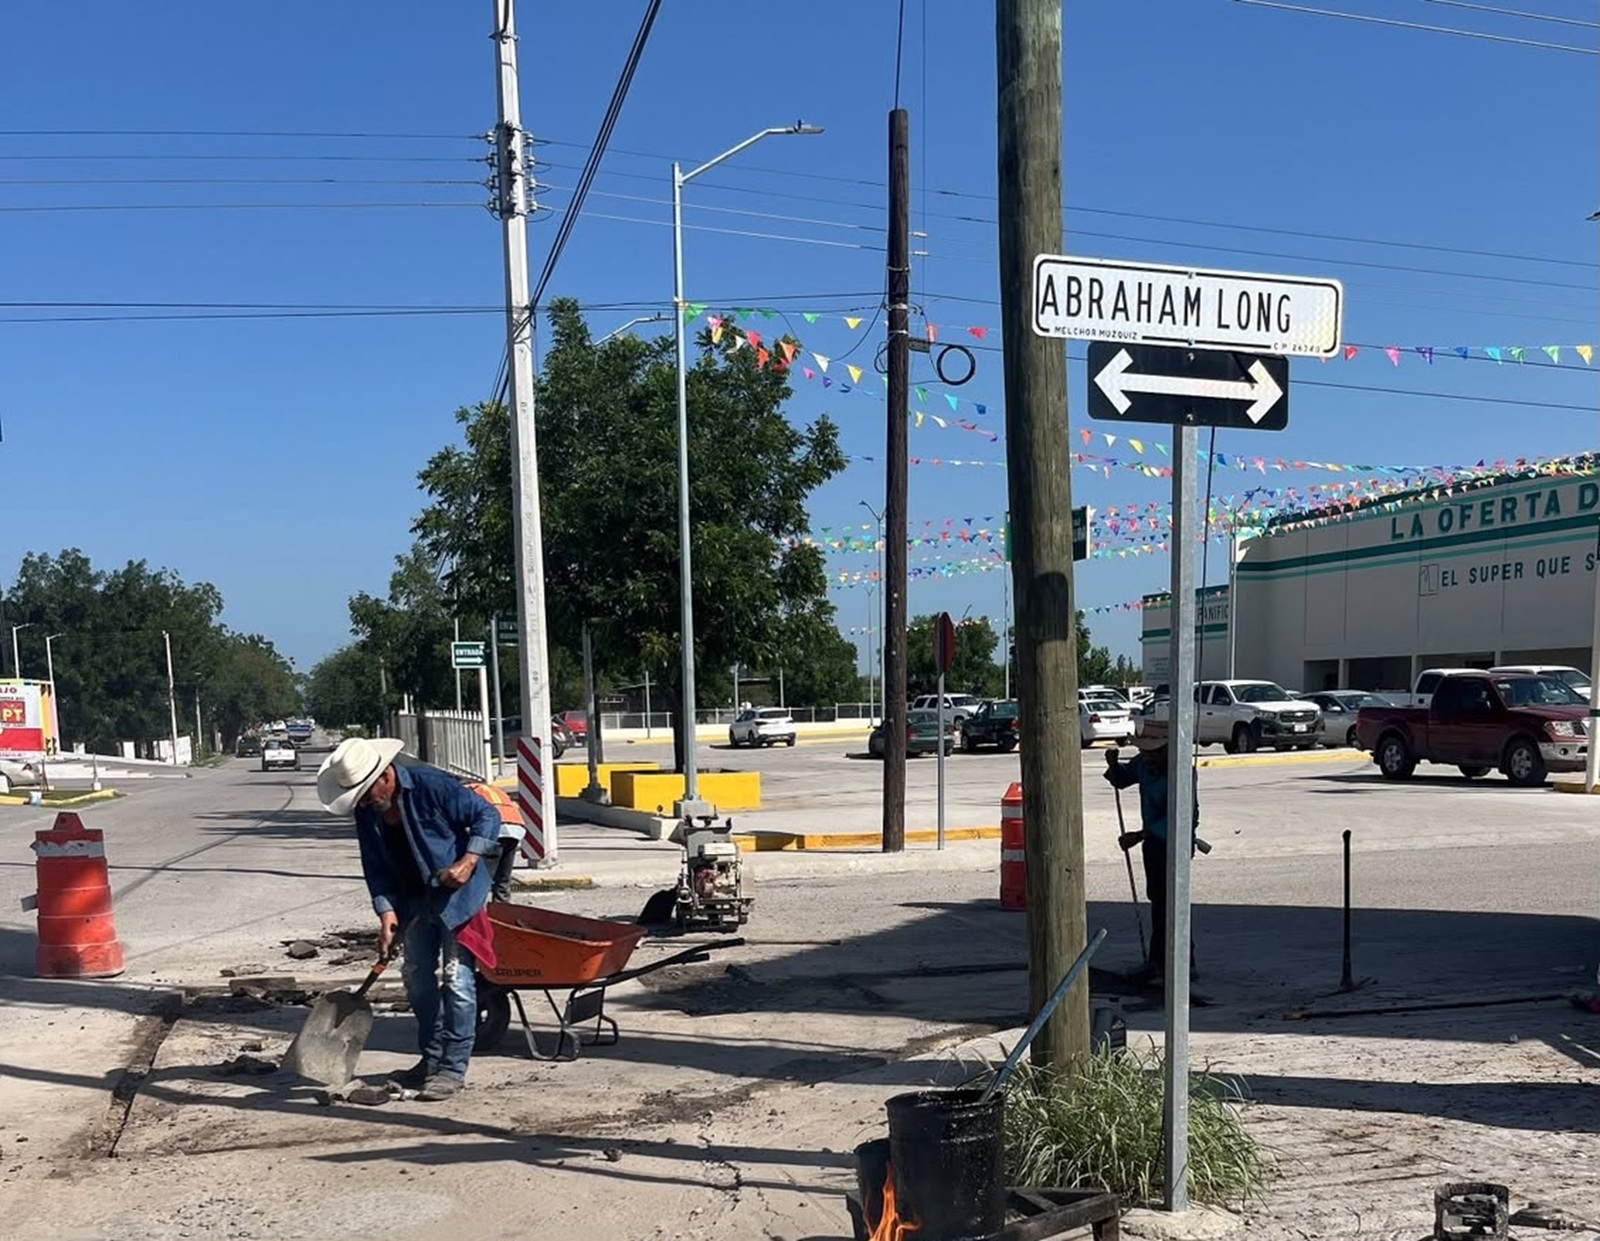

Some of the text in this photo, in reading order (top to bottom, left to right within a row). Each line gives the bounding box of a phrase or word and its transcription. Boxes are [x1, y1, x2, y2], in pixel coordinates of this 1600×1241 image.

[1040, 273, 1291, 334] ABRAHAM LONG
[1054, 326, 1138, 340] MELCHOR MUZQUIZ
[1391, 513, 1424, 541] LA
[1438, 490, 1560, 532] OFERTA
[1441, 570, 1458, 587] EL
[1469, 562, 1523, 584] SUPER
[1536, 556, 1571, 579] QUE
[455, 648, 484, 656] ENTRADA
[2, 708, 23, 722] PT
